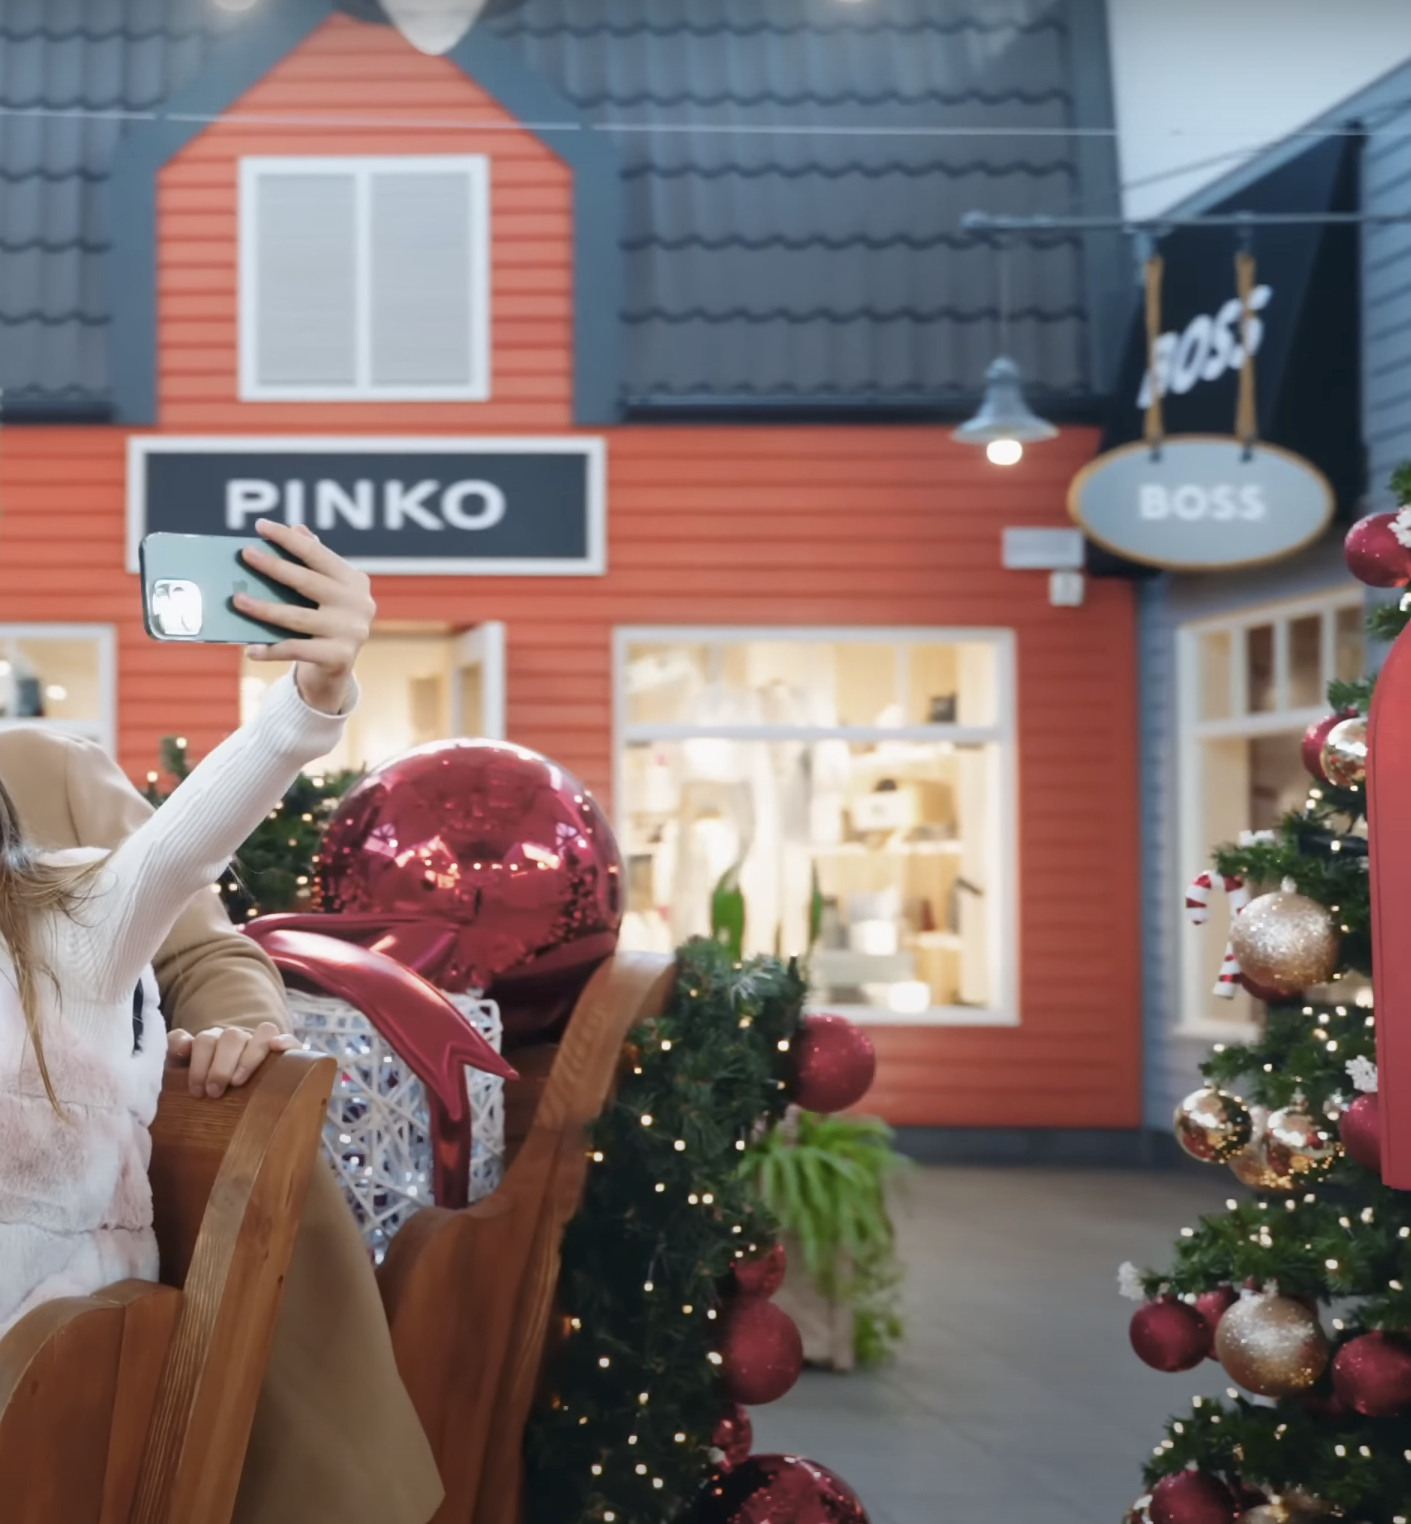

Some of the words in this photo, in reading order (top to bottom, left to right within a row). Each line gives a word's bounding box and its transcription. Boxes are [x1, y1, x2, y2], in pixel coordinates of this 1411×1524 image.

[1137, 284, 1273, 409] BOSS
[226, 479, 507, 530] PINKO
[1140, 484, 1267, 520] BOSS
